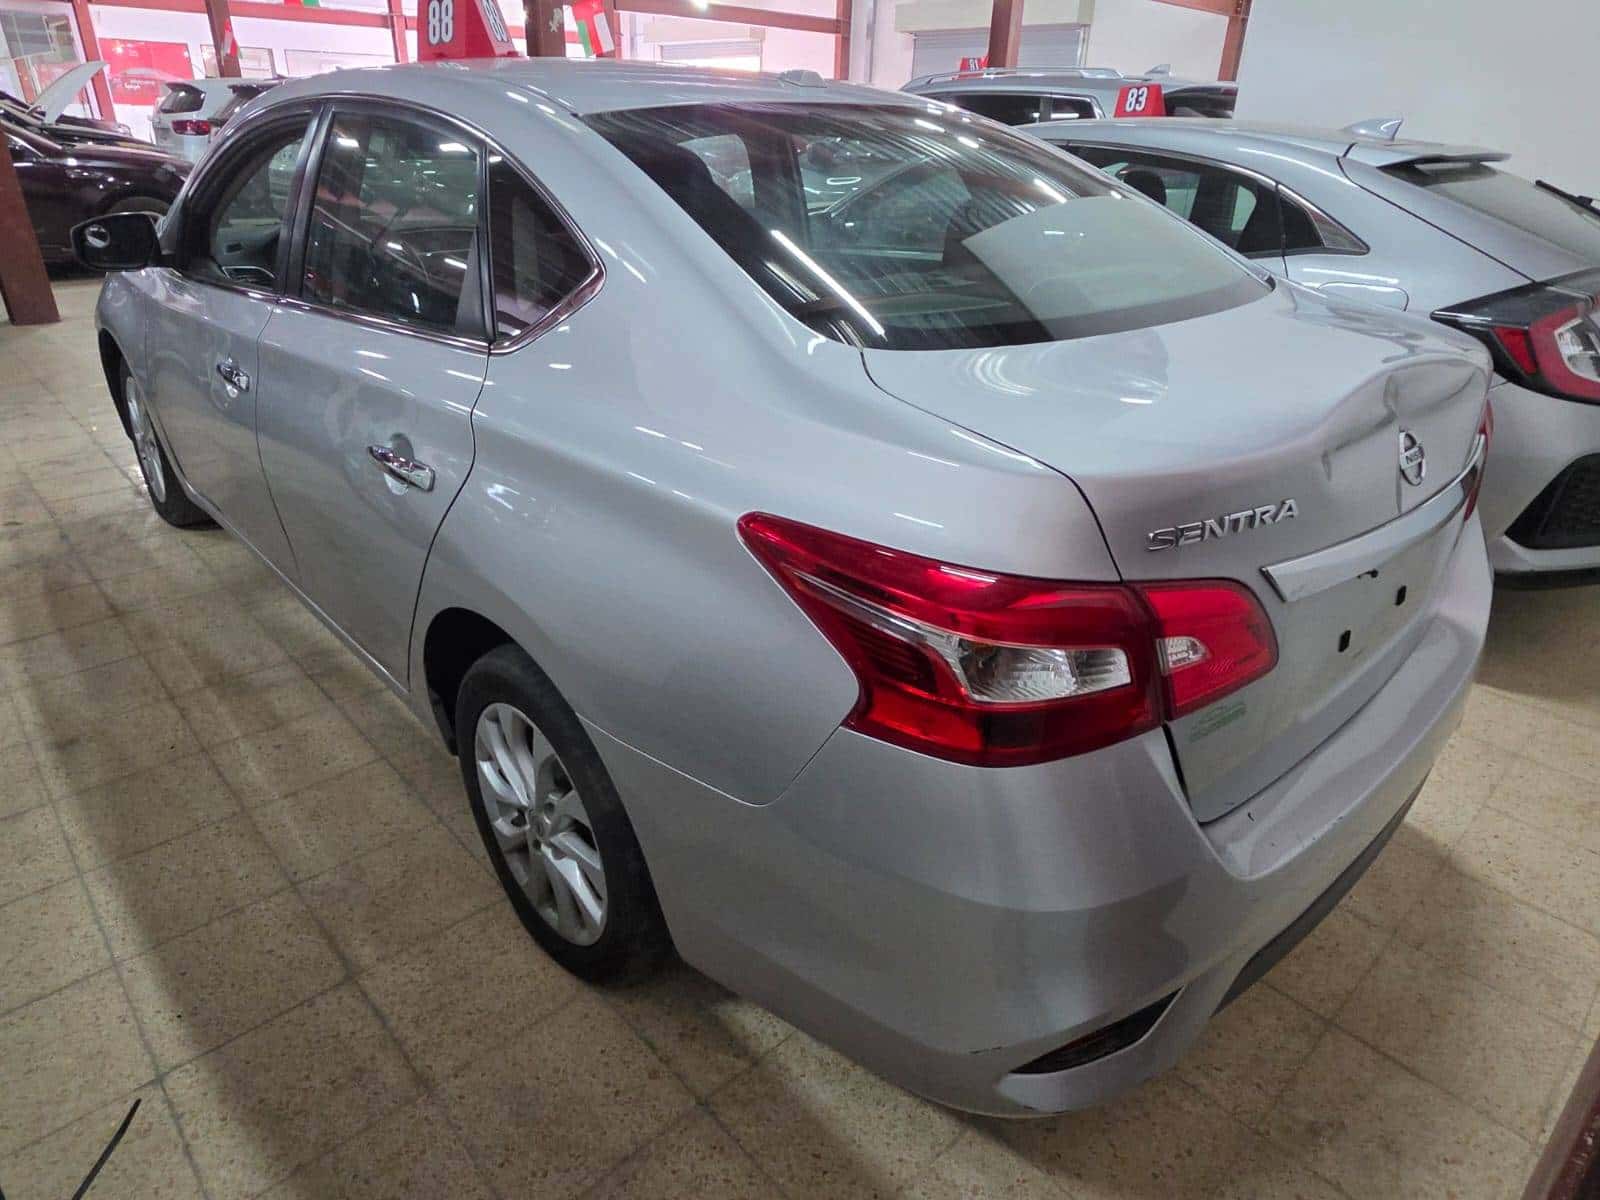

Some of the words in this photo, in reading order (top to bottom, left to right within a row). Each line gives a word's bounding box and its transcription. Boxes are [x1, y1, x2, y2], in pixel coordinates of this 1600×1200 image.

[428, 0, 453, 45] 88
[480, 0, 509, 43] 88
[1125, 86, 1148, 113] 83
[1146, 498, 1299, 551] SENTRA
